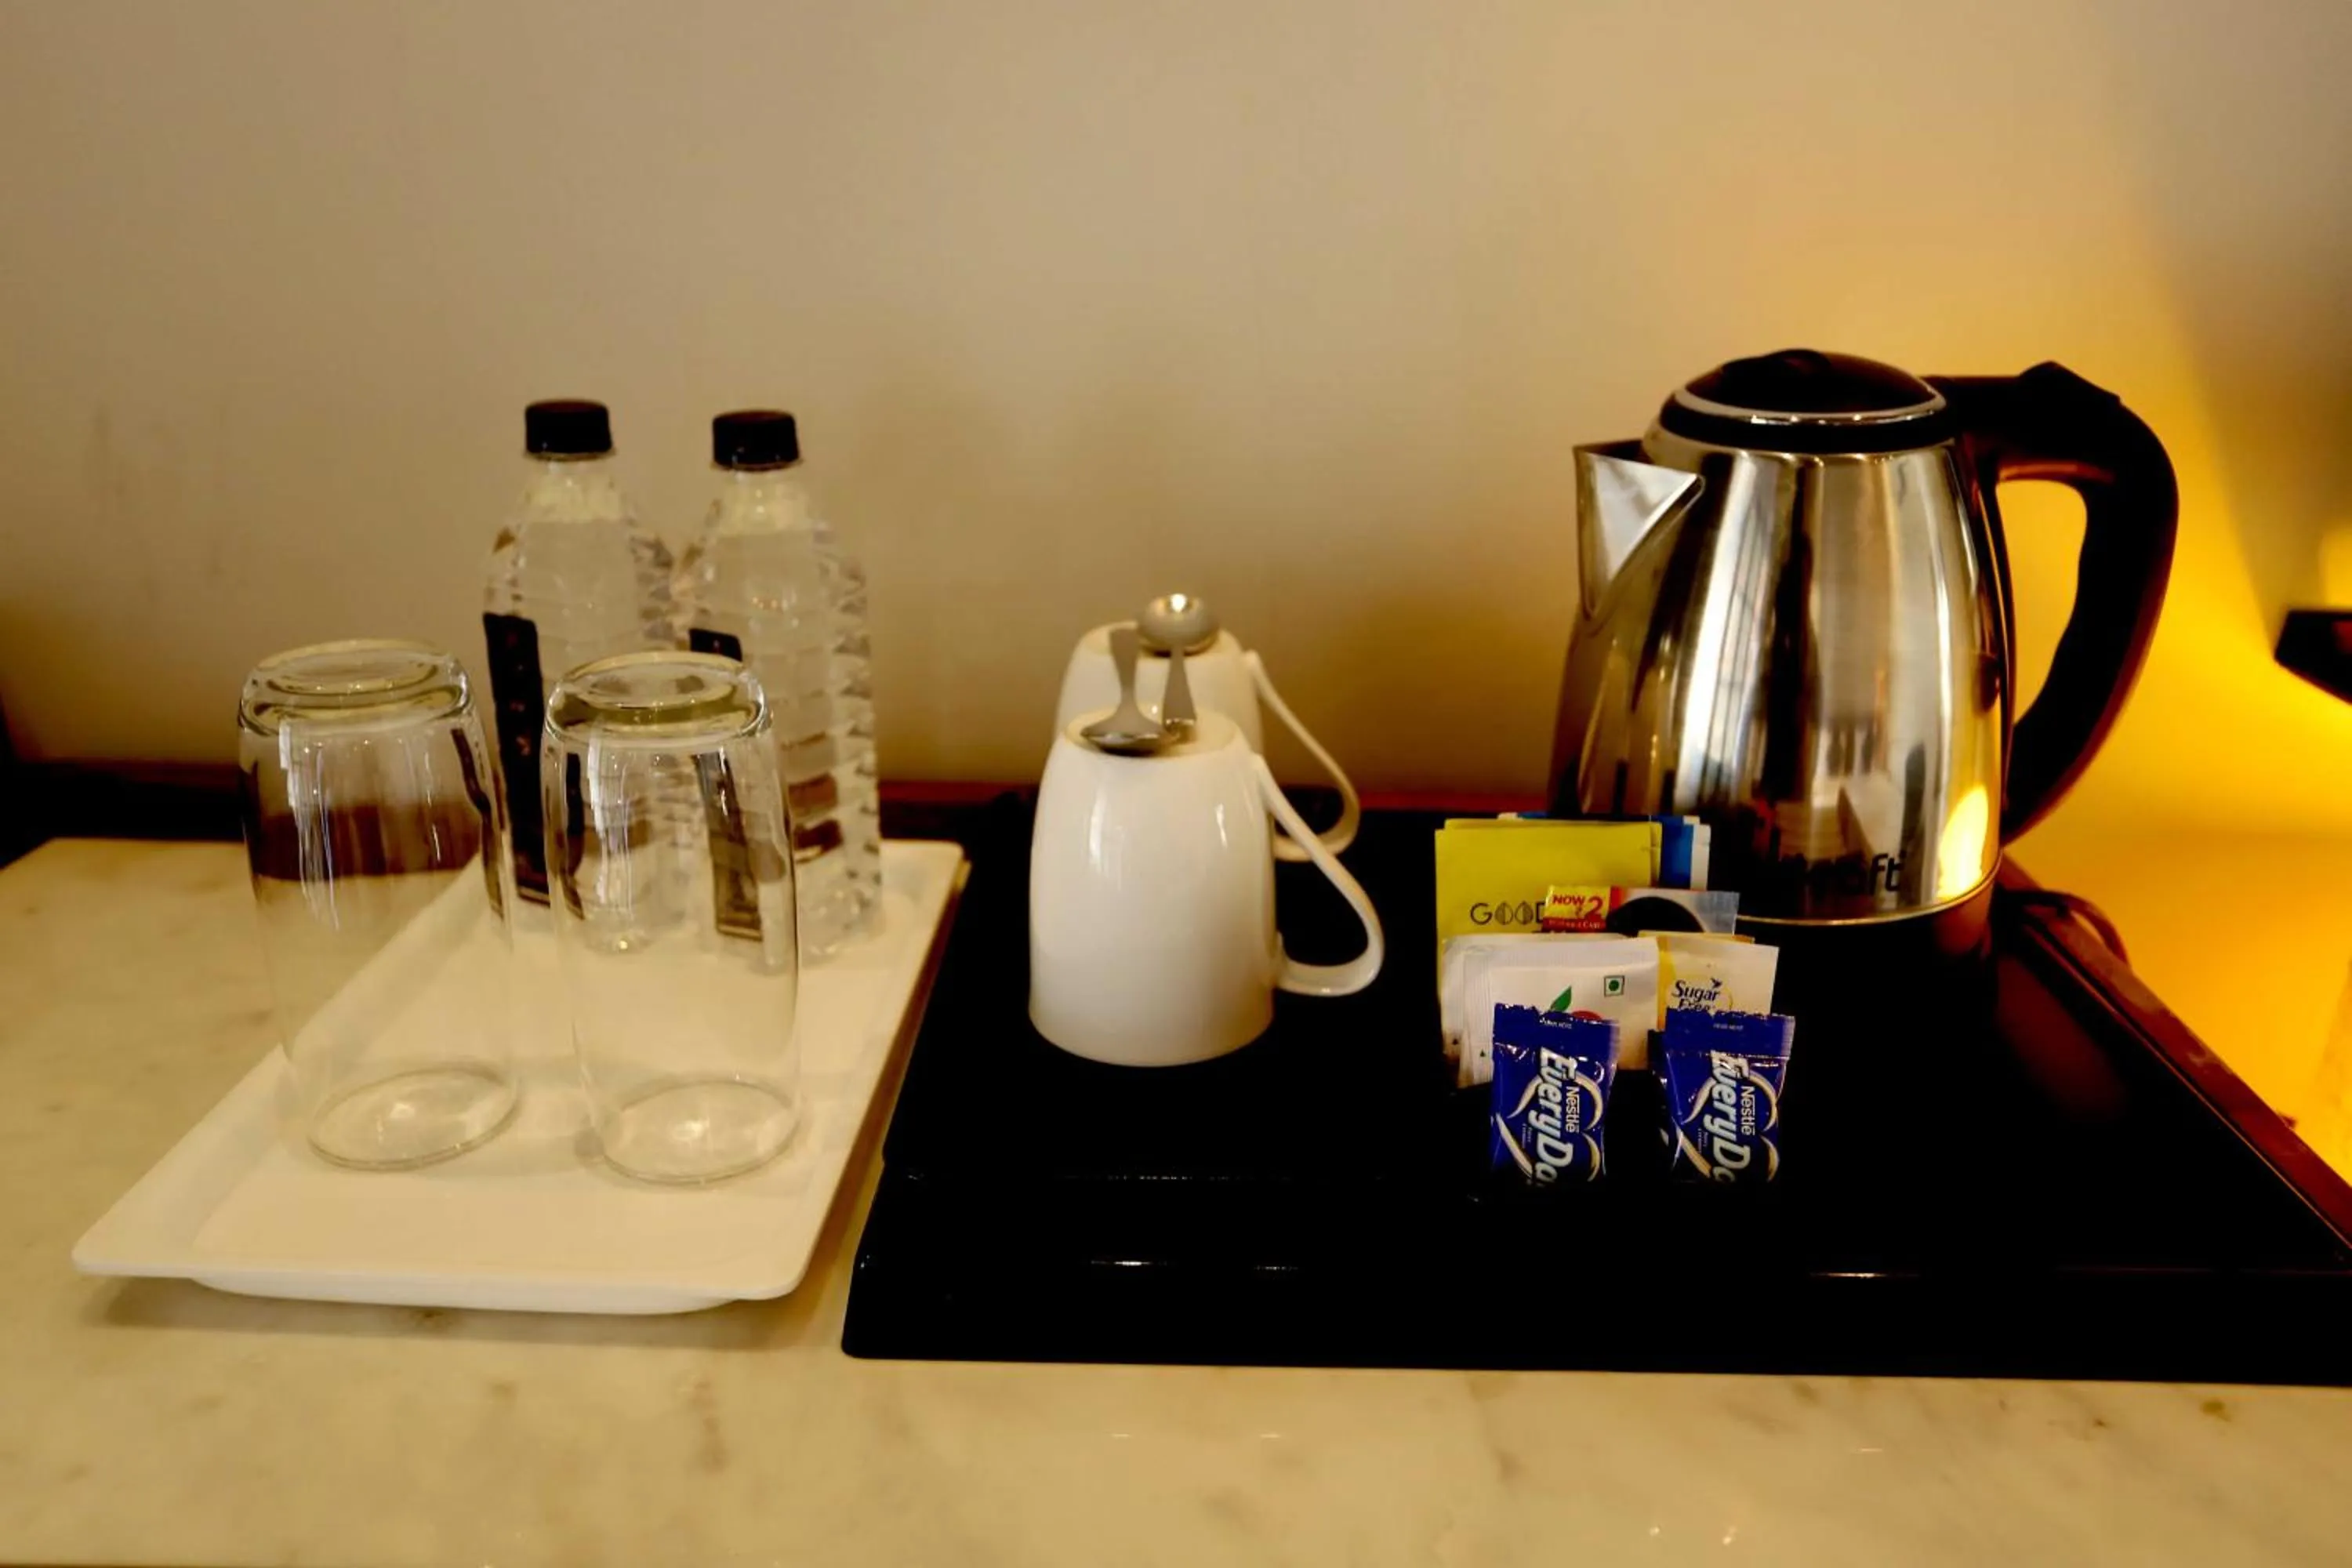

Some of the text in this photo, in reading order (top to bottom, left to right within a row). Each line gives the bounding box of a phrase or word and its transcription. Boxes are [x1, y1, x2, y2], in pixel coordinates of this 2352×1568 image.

[1552, 895, 1585, 906] NOW
[1671, 978, 1720, 1002] Sugar
[1526, 1045, 1579, 1187] EveryDa
